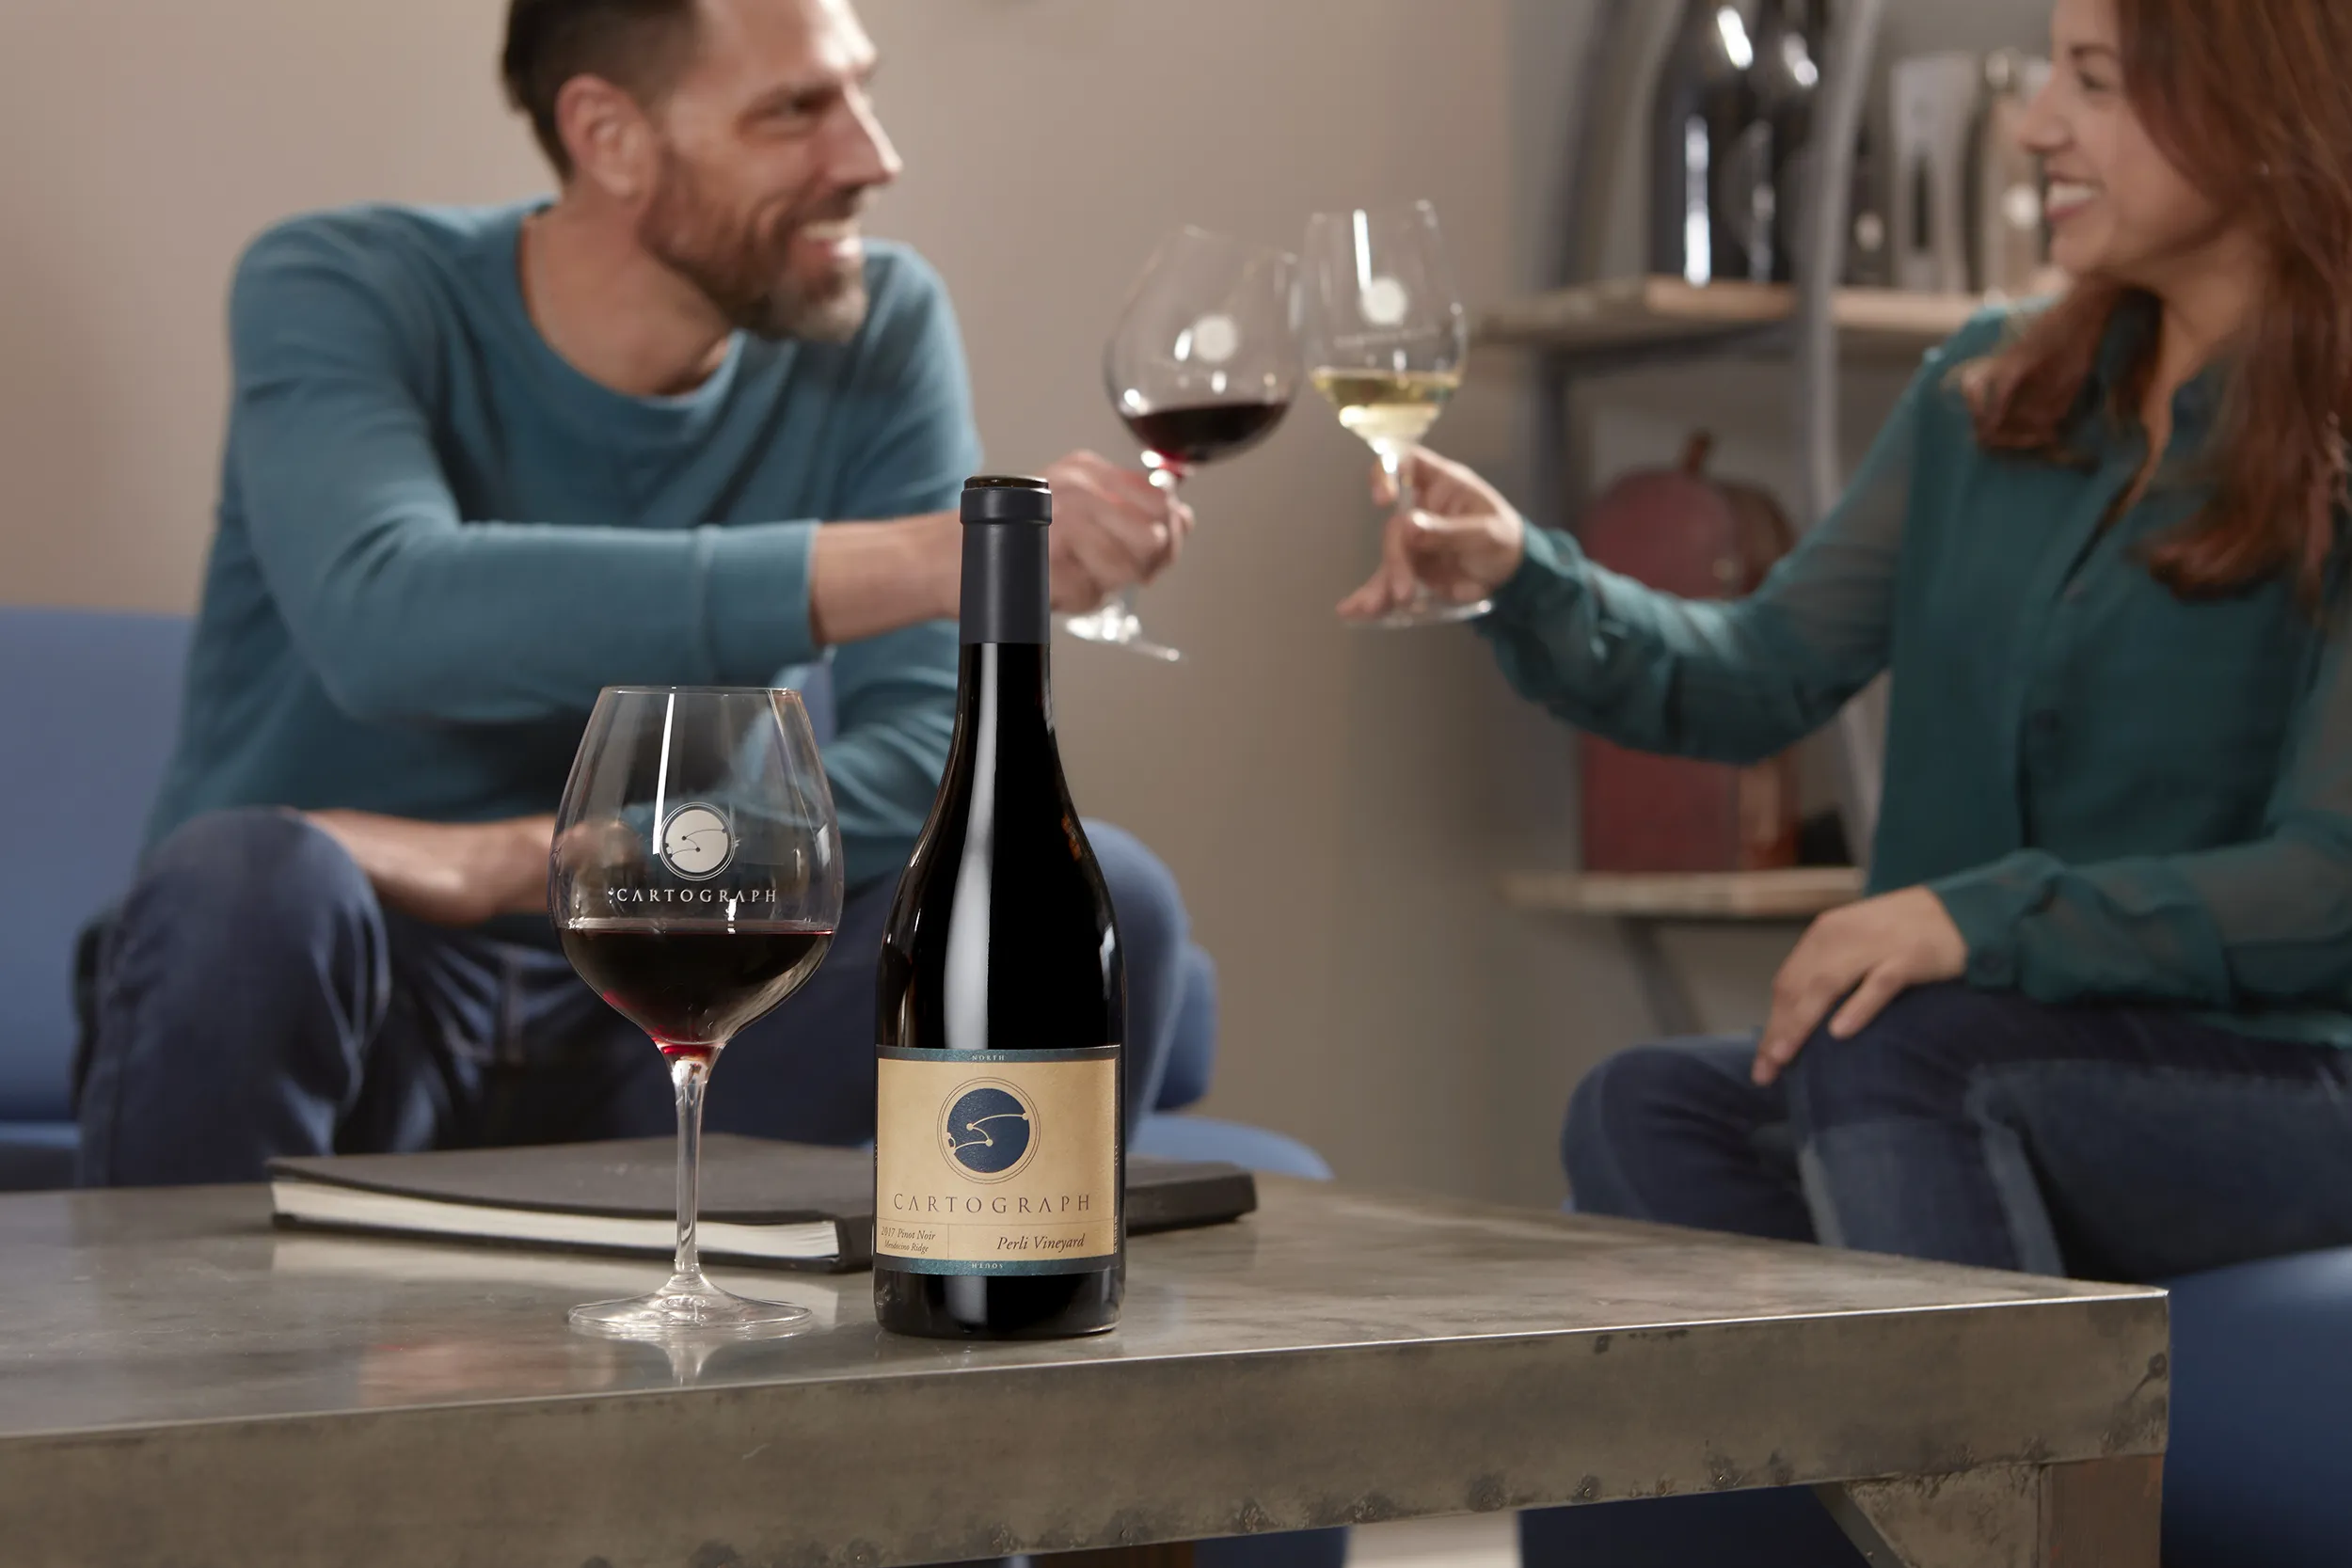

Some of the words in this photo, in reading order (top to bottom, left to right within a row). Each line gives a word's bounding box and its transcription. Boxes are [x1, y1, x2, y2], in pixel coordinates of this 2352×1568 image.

[616, 888, 777, 903] CARTOGRAPH
[893, 1193, 1090, 1214] CARTOGRAPH
[881, 1226, 896, 1237] 2017
[897, 1227, 915, 1239] Pinot
[916, 1229, 936, 1241] Noir
[911, 1242, 930, 1255] Ridge
[996, 1235, 1028, 1250] Perli
[1034, 1233, 1086, 1253] Vineyard
